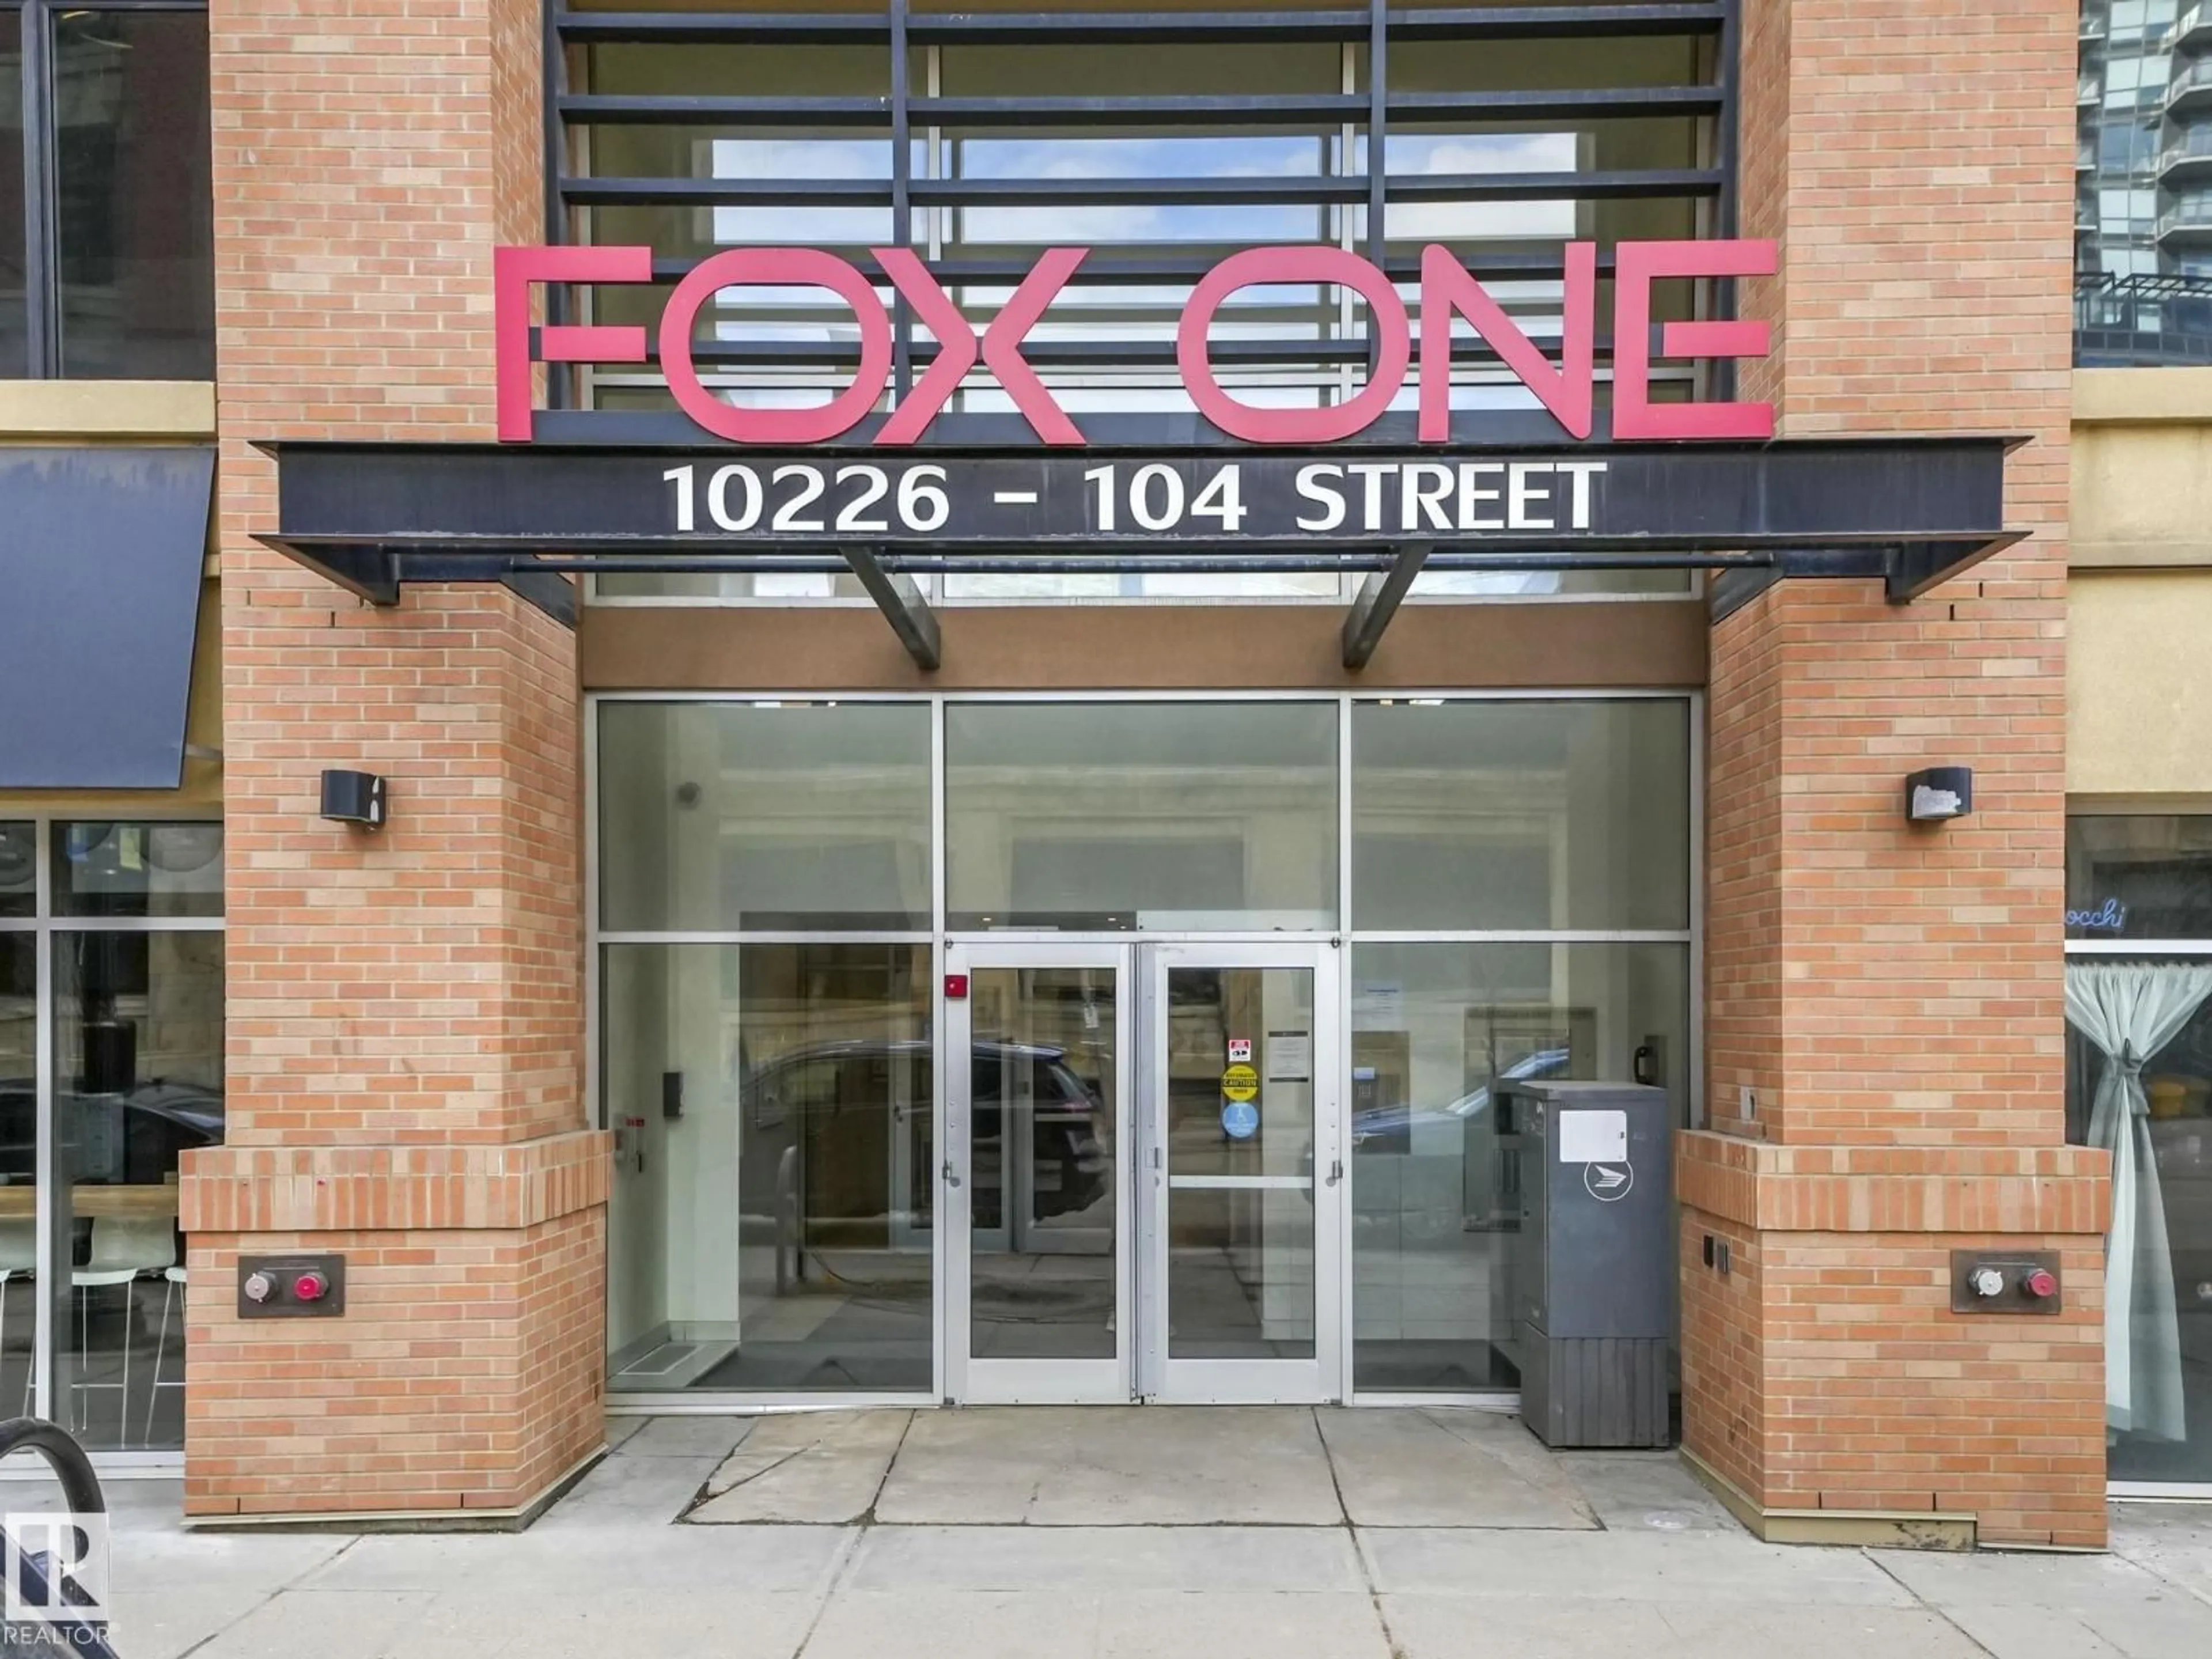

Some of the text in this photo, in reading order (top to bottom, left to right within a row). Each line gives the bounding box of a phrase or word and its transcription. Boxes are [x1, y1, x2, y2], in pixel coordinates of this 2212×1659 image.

[494, 240, 1778, 445] FOX ONE
[662, 464, 950, 532] 10226
[1084, 463, 1247, 531] 104
[1294, 462, 1609, 531] STREET
